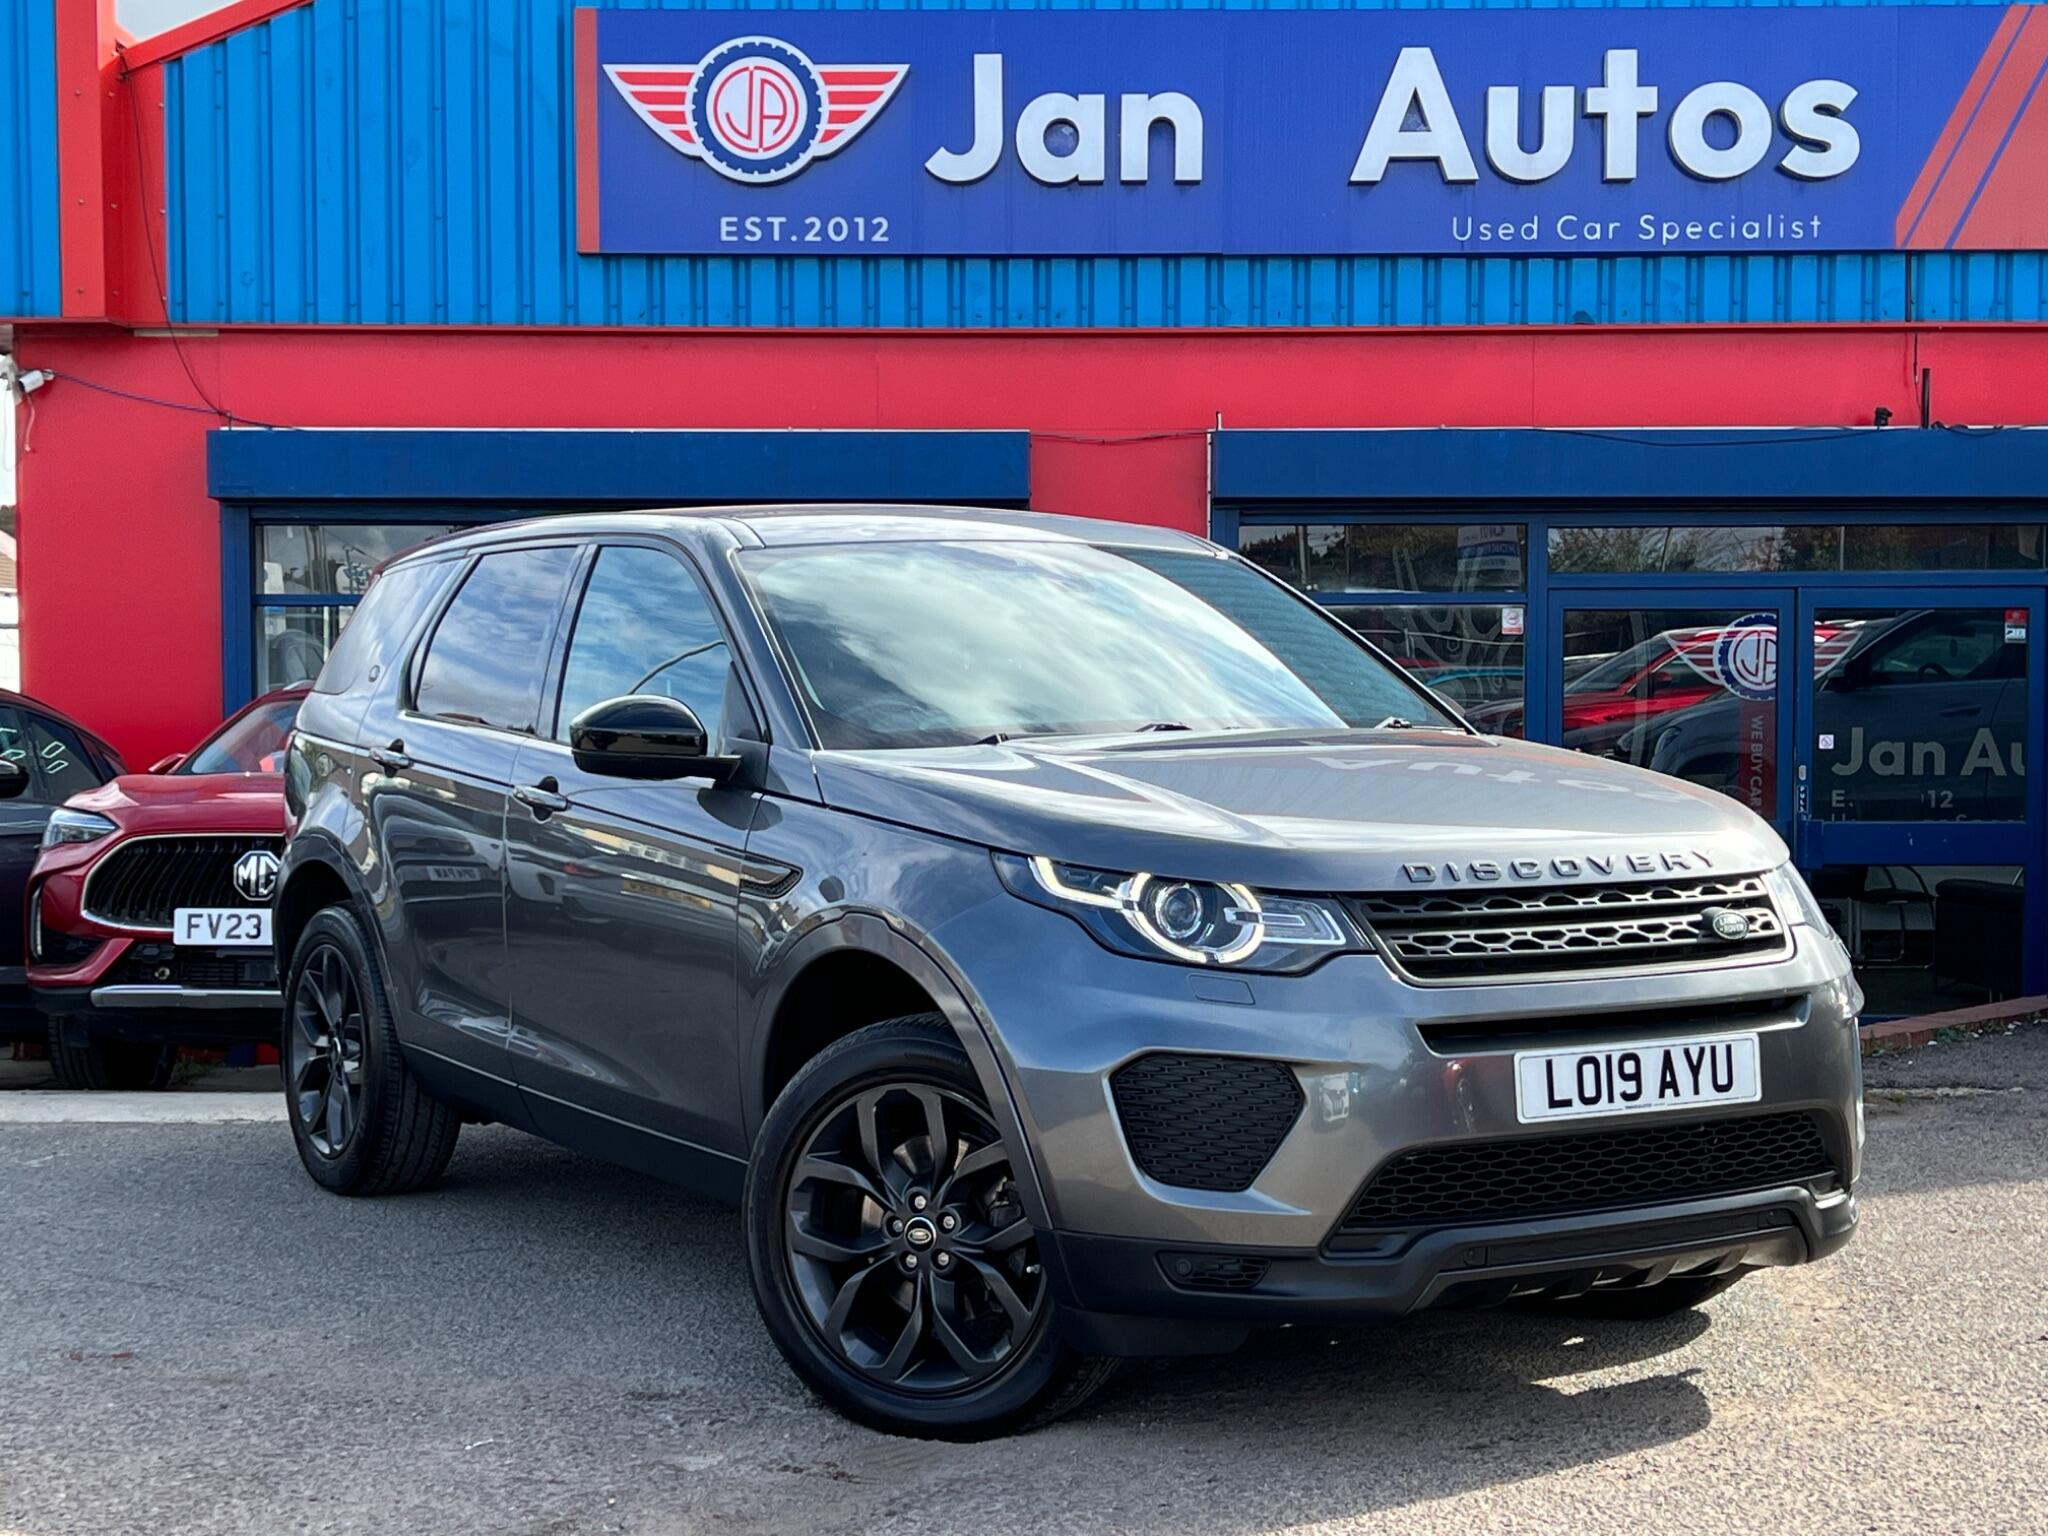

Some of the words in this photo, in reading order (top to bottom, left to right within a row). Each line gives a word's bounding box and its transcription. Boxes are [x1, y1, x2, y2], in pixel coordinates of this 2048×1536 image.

[924, 53, 1203, 184] Jan
[1348, 46, 1861, 184] Autos
[719, 216, 890, 242] EST.2012
[1451, 215, 1539, 241] Used
[1556, 215, 1621, 241] Car
[1638, 214, 1822, 245] Specialist
[1751, 715, 1764, 739] WE
[1750, 743, 1764, 773] BUY
[1831, 726, 1946, 776] Jan
[1750, 776, 1763, 814] CAR
[238, 855, 278, 896] MG
[1402, 850, 1715, 883] DISCOVERY
[186, 912, 263, 940] FV23
[1545, 1051, 1643, 1109] LO19
[1658, 1043, 1734, 1099] AYU
